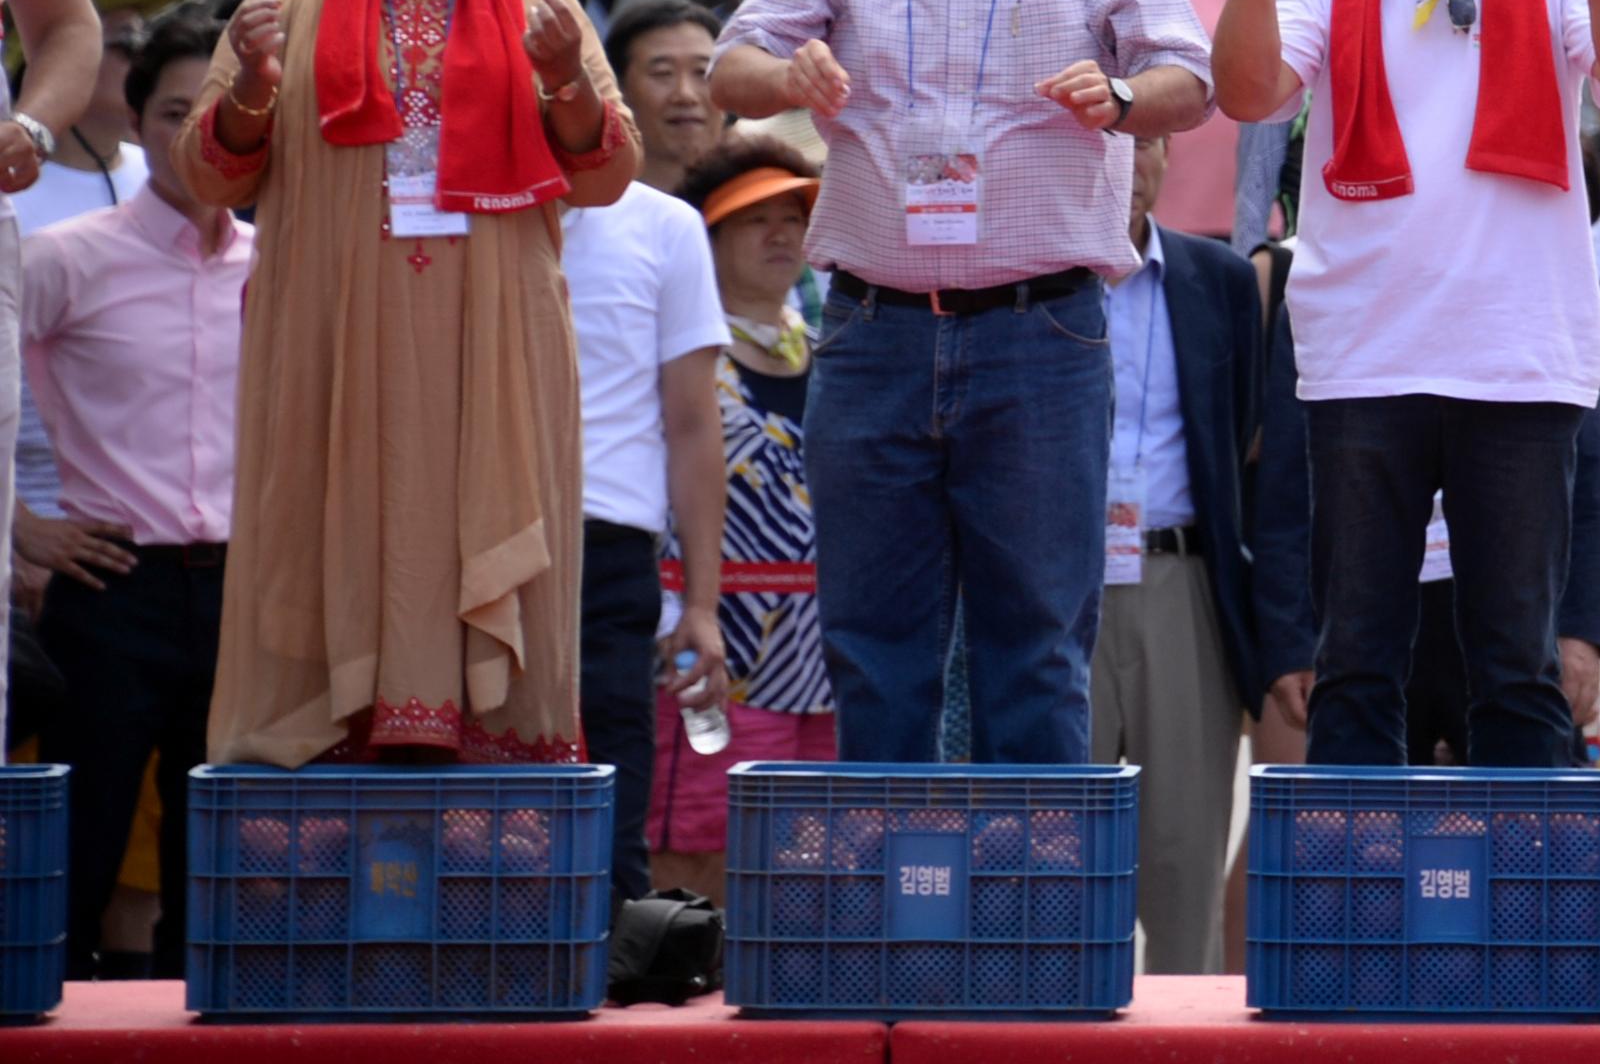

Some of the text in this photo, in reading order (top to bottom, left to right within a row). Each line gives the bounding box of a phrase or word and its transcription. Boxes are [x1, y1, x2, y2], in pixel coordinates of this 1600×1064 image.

[474, 191, 536, 210] renoma
[899, 865, 951, 896] 김영범
[1419, 868, 1471, 899] 김영범
